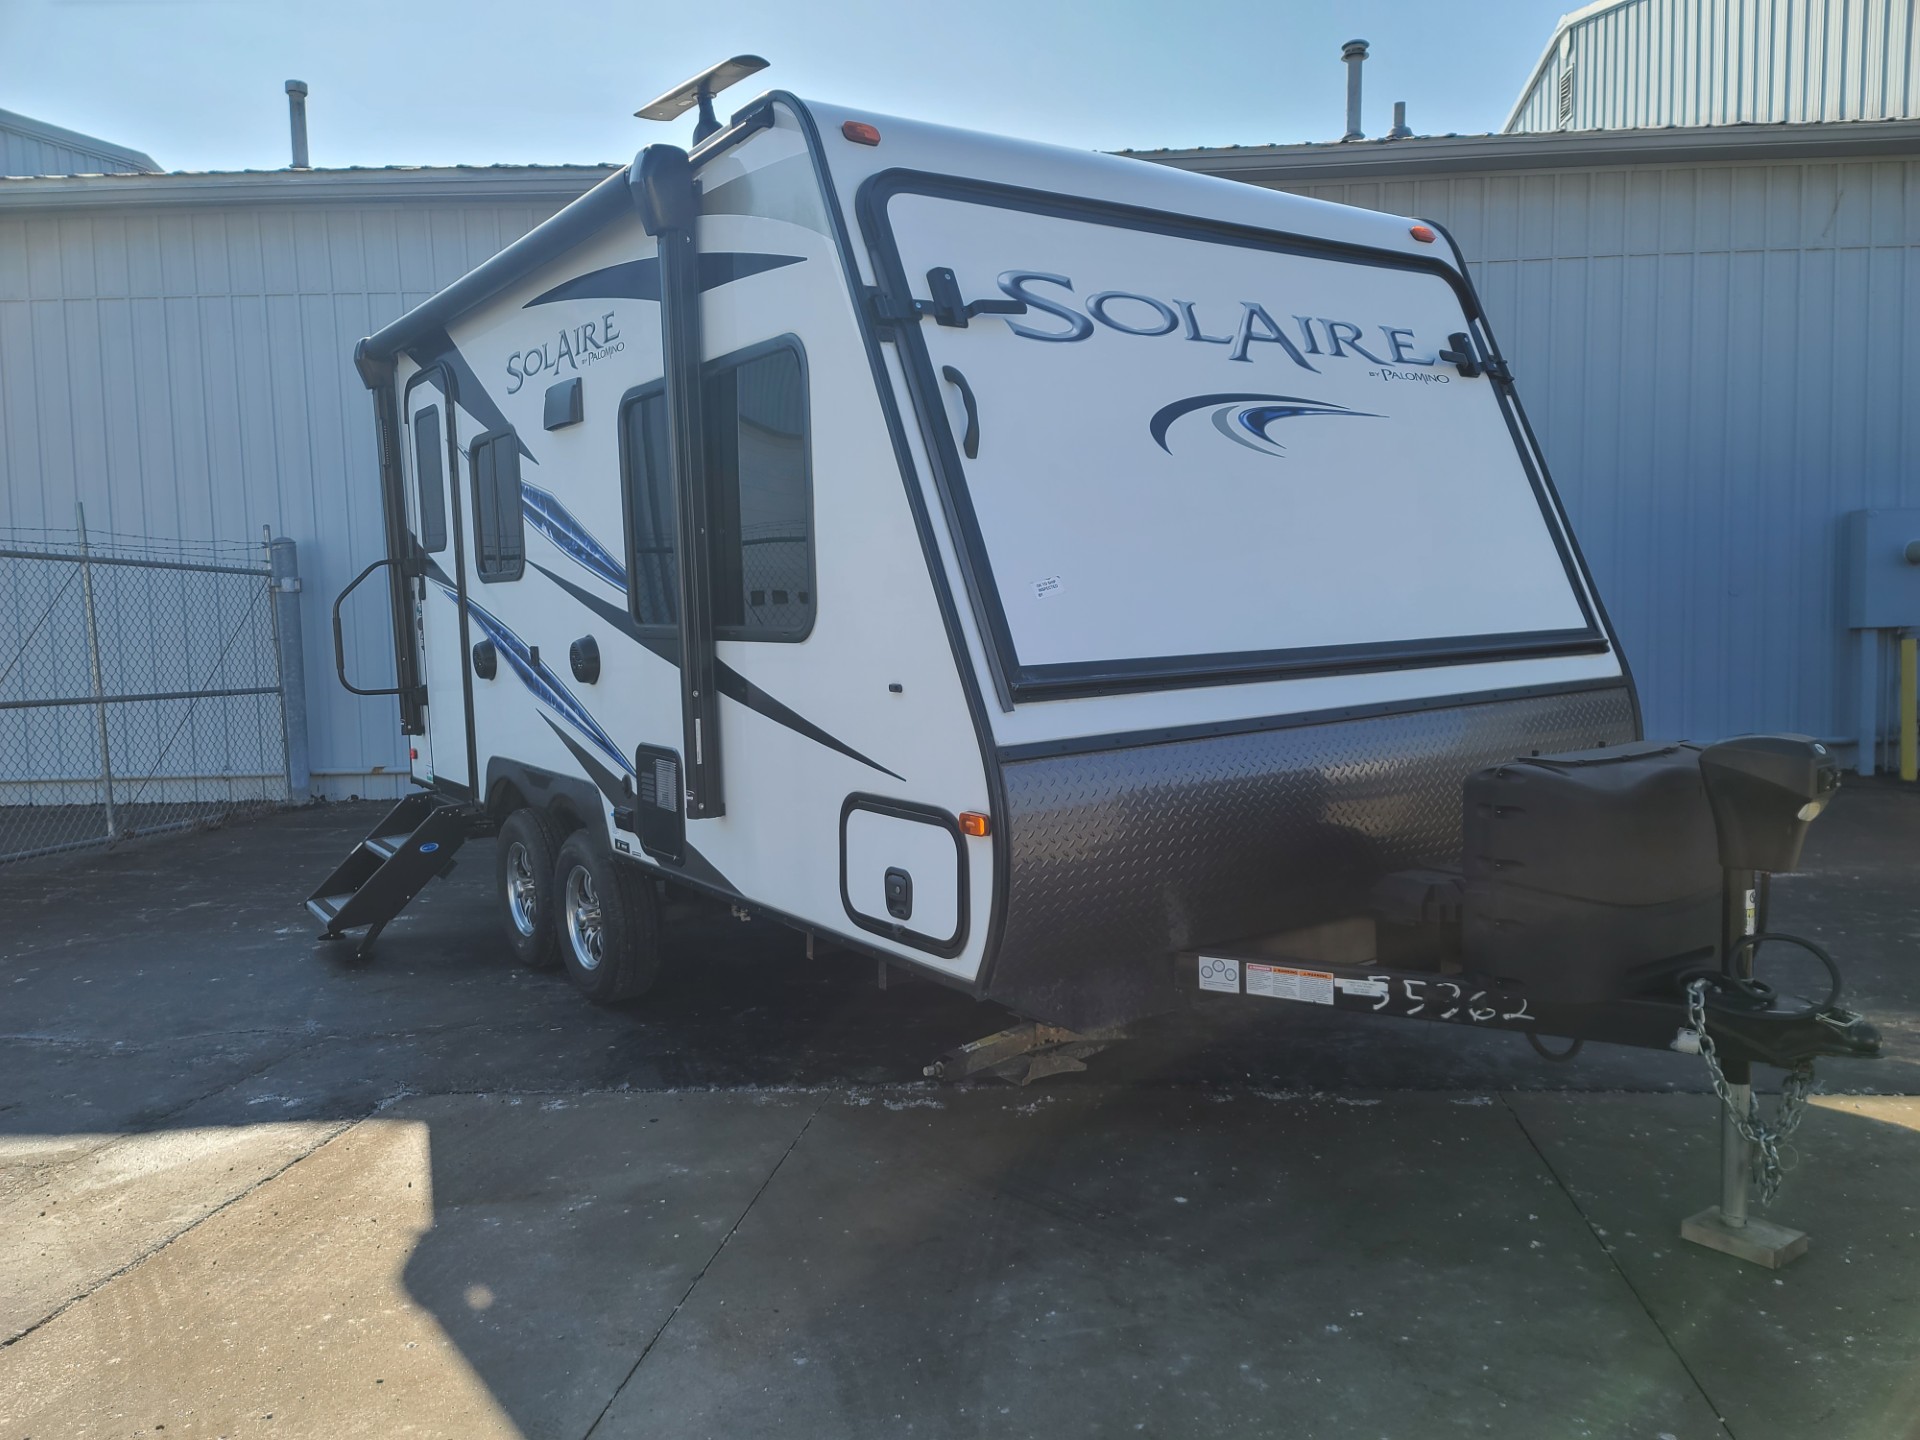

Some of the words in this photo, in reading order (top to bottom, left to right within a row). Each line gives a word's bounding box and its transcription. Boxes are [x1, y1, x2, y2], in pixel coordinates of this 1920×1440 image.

[997, 269, 1435, 374] SOLAIRE
[506, 310, 621, 395] SOLAIRE
[588, 342, 625, 366] PALOMINO
[1381, 368, 1450, 385] PALOMINO
